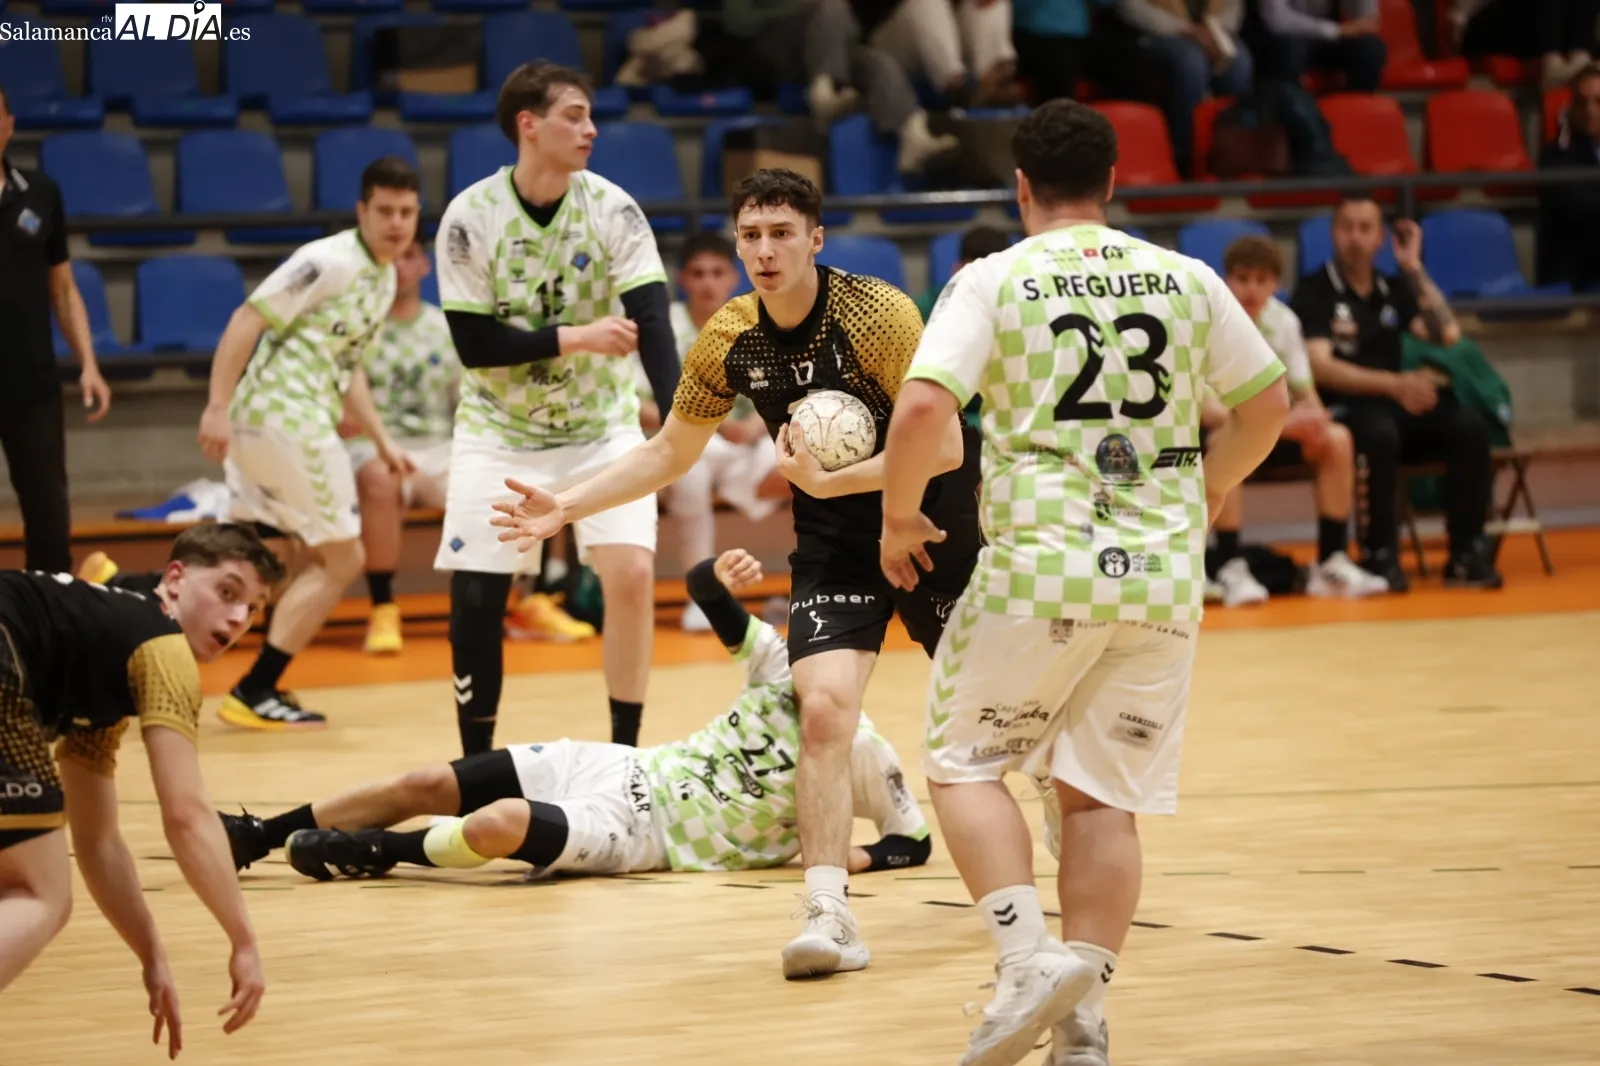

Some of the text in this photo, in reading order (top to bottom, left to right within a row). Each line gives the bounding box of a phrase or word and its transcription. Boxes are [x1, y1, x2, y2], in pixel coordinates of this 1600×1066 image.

[1023, 273, 1183, 301] S. REGUERA
[1049, 312, 1172, 422] 23
[791, 593, 876, 614] pubeer
[739, 732, 796, 778] 27
